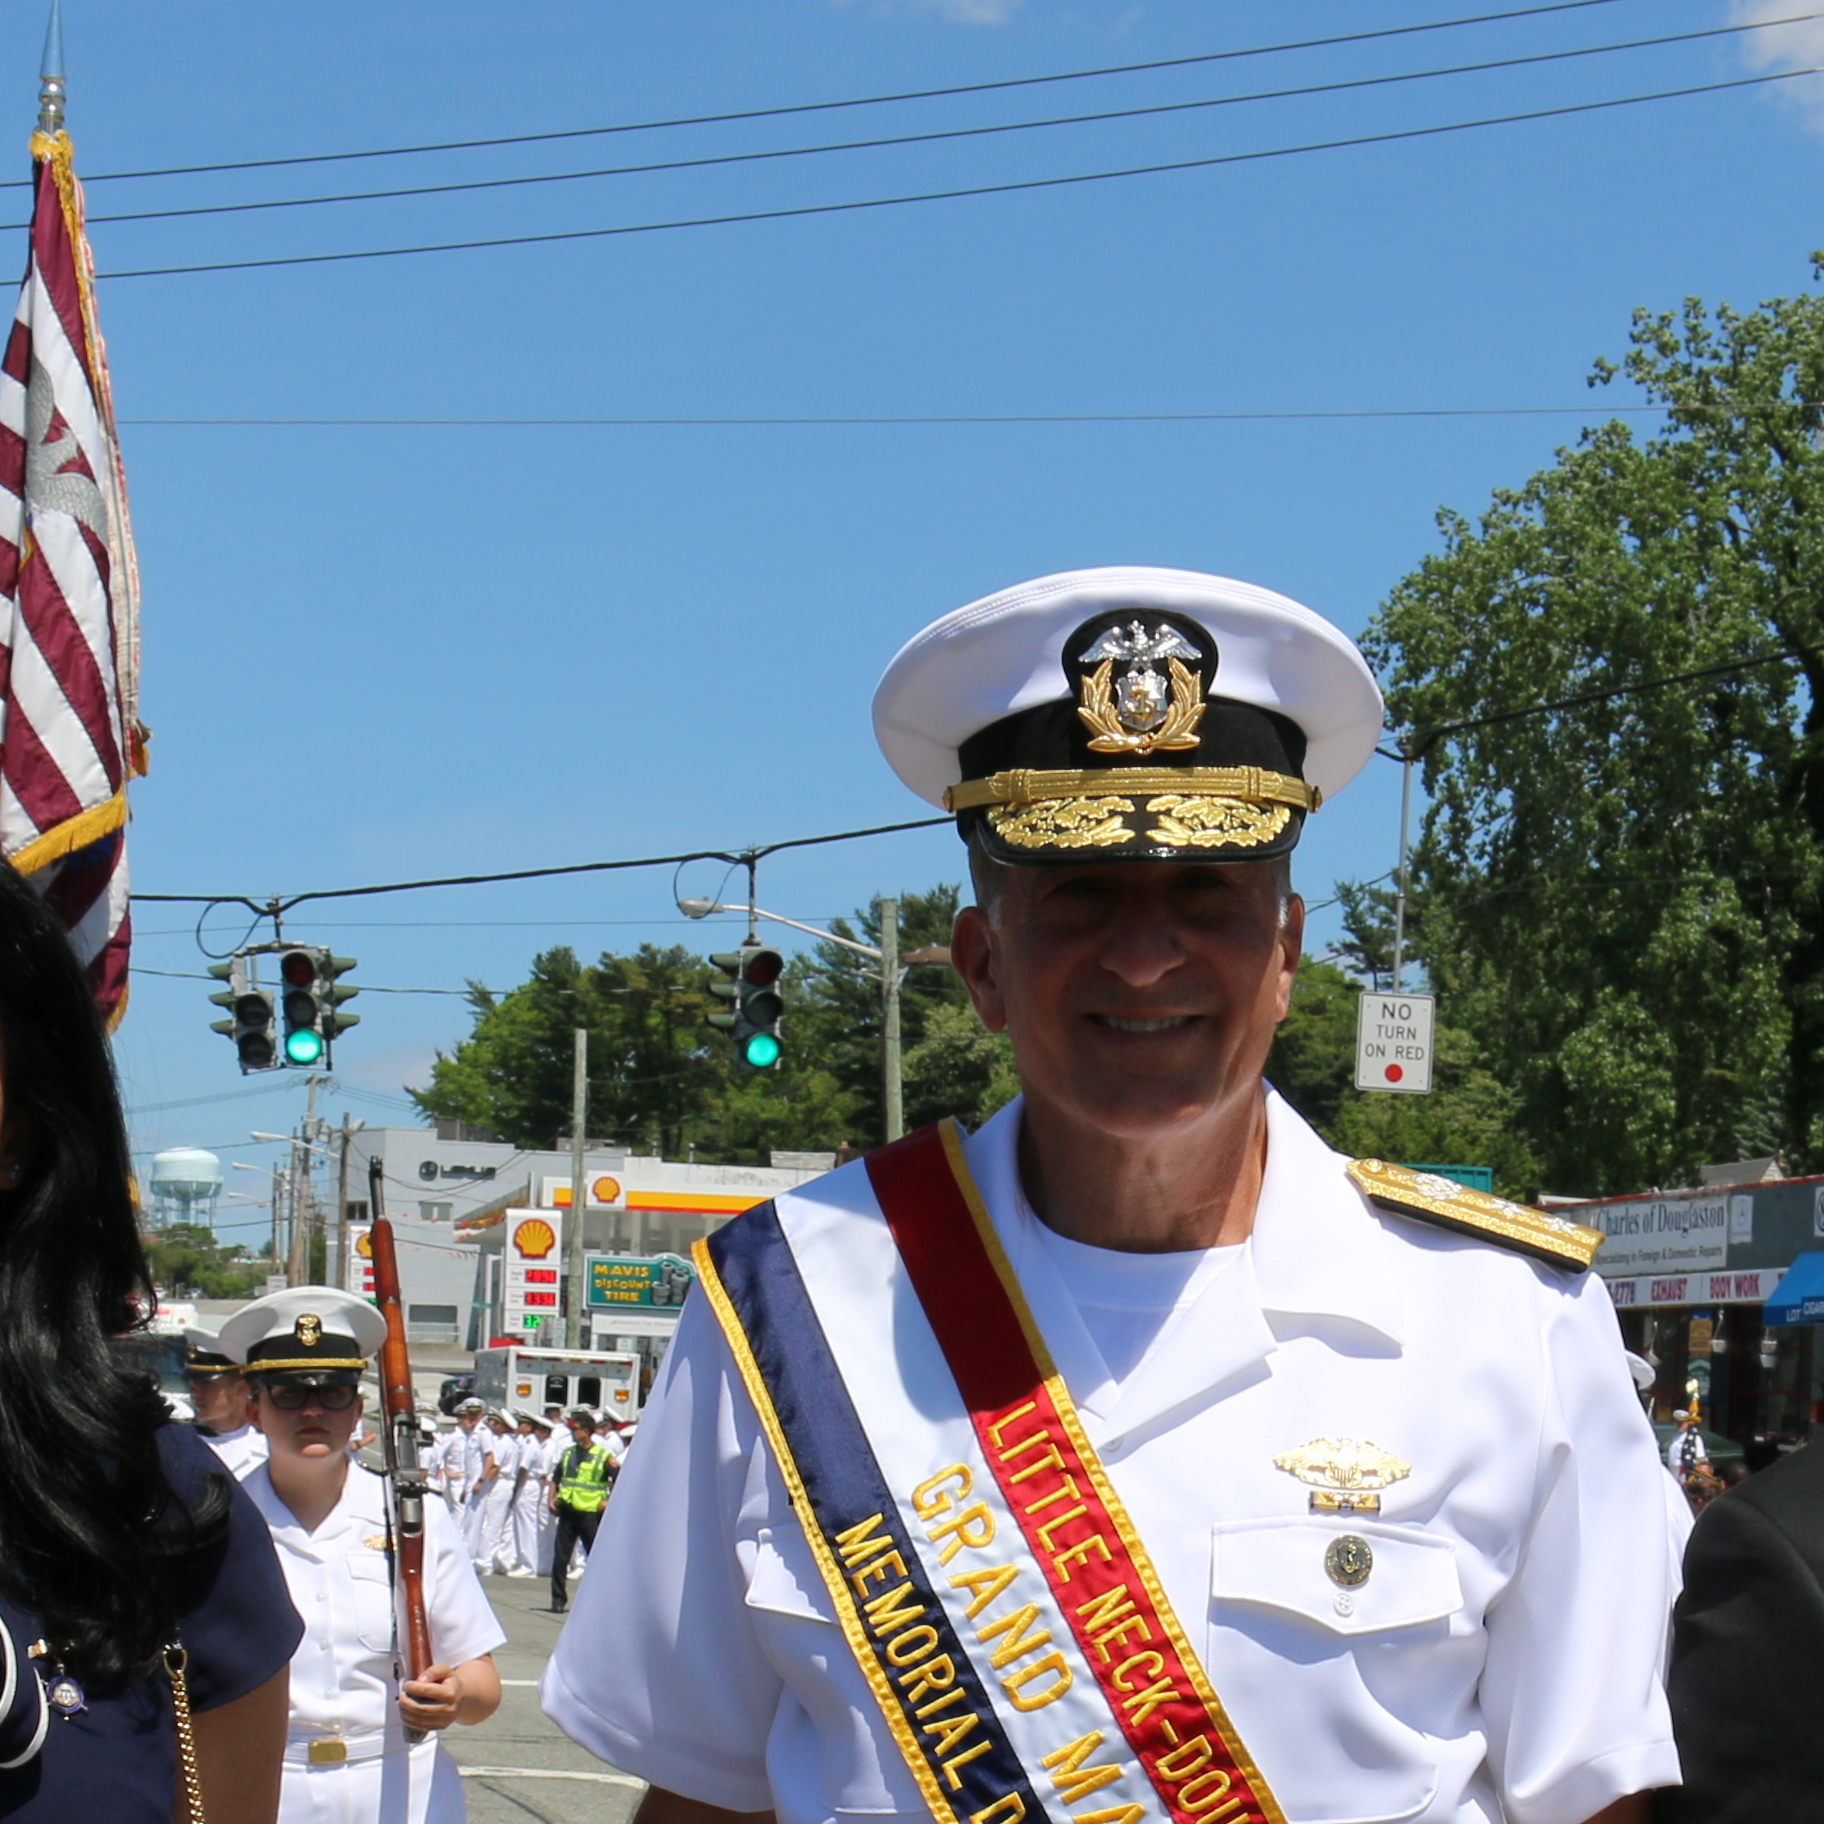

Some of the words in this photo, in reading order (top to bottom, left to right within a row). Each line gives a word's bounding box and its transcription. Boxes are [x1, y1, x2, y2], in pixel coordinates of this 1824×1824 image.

[1382, 1002, 1412, 1020] NO
[1377, 1024, 1417, 1040] TURN
[1365, 1043, 1385, 1057] ON
[1395, 1045, 1424, 1060] RED
[1597, 1206, 1639, 1236] Charles
[1643, 1204, 1656, 1233] of
[1657, 1203, 1725, 1239] Douglaston
[594, 1264, 650, 1277] MAVIS
[604, 1290, 641, 1302] TIRE
[1651, 1278, 1688, 1301] EXHAUST
[1710, 1275, 1732, 1299] BODY
[1734, 1273, 1761, 1298] WORK
[987, 1401, 1113, 1584] LITTLE
[911, 1462, 1073, 1712] GRAND
[834, 1512, 993, 1790] MEMORIAL
